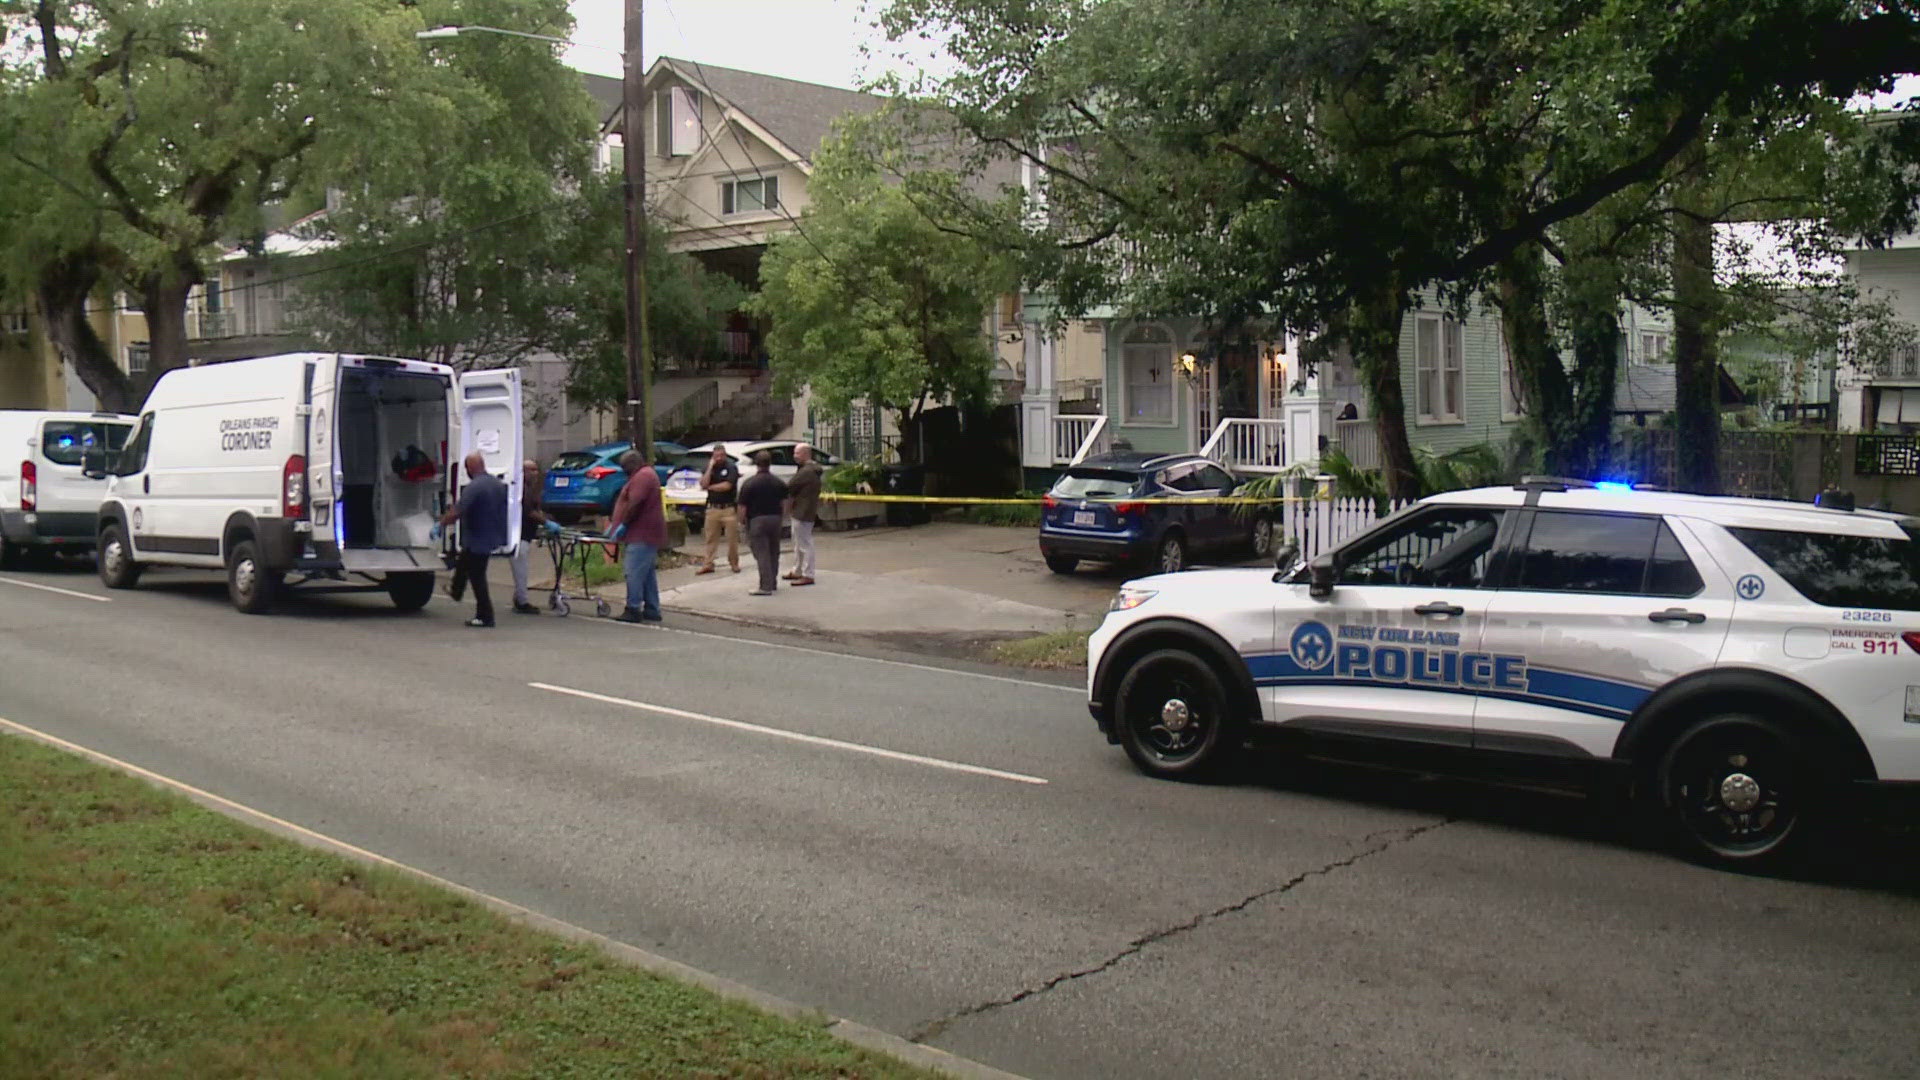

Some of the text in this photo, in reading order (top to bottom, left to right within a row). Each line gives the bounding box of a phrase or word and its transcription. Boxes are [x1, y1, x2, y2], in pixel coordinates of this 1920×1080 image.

[220, 416, 279, 432] ORLEANS PARISH
[222, 431, 272, 451] CORONER
[1842, 611, 1892, 622] 23226
[1337, 625, 1460, 646] NEW ORLEANS
[1832, 629, 1897, 640] EMERGENCY
[1832, 640, 1898, 655] CALL 911
[1336, 642, 1528, 692] POLICE
